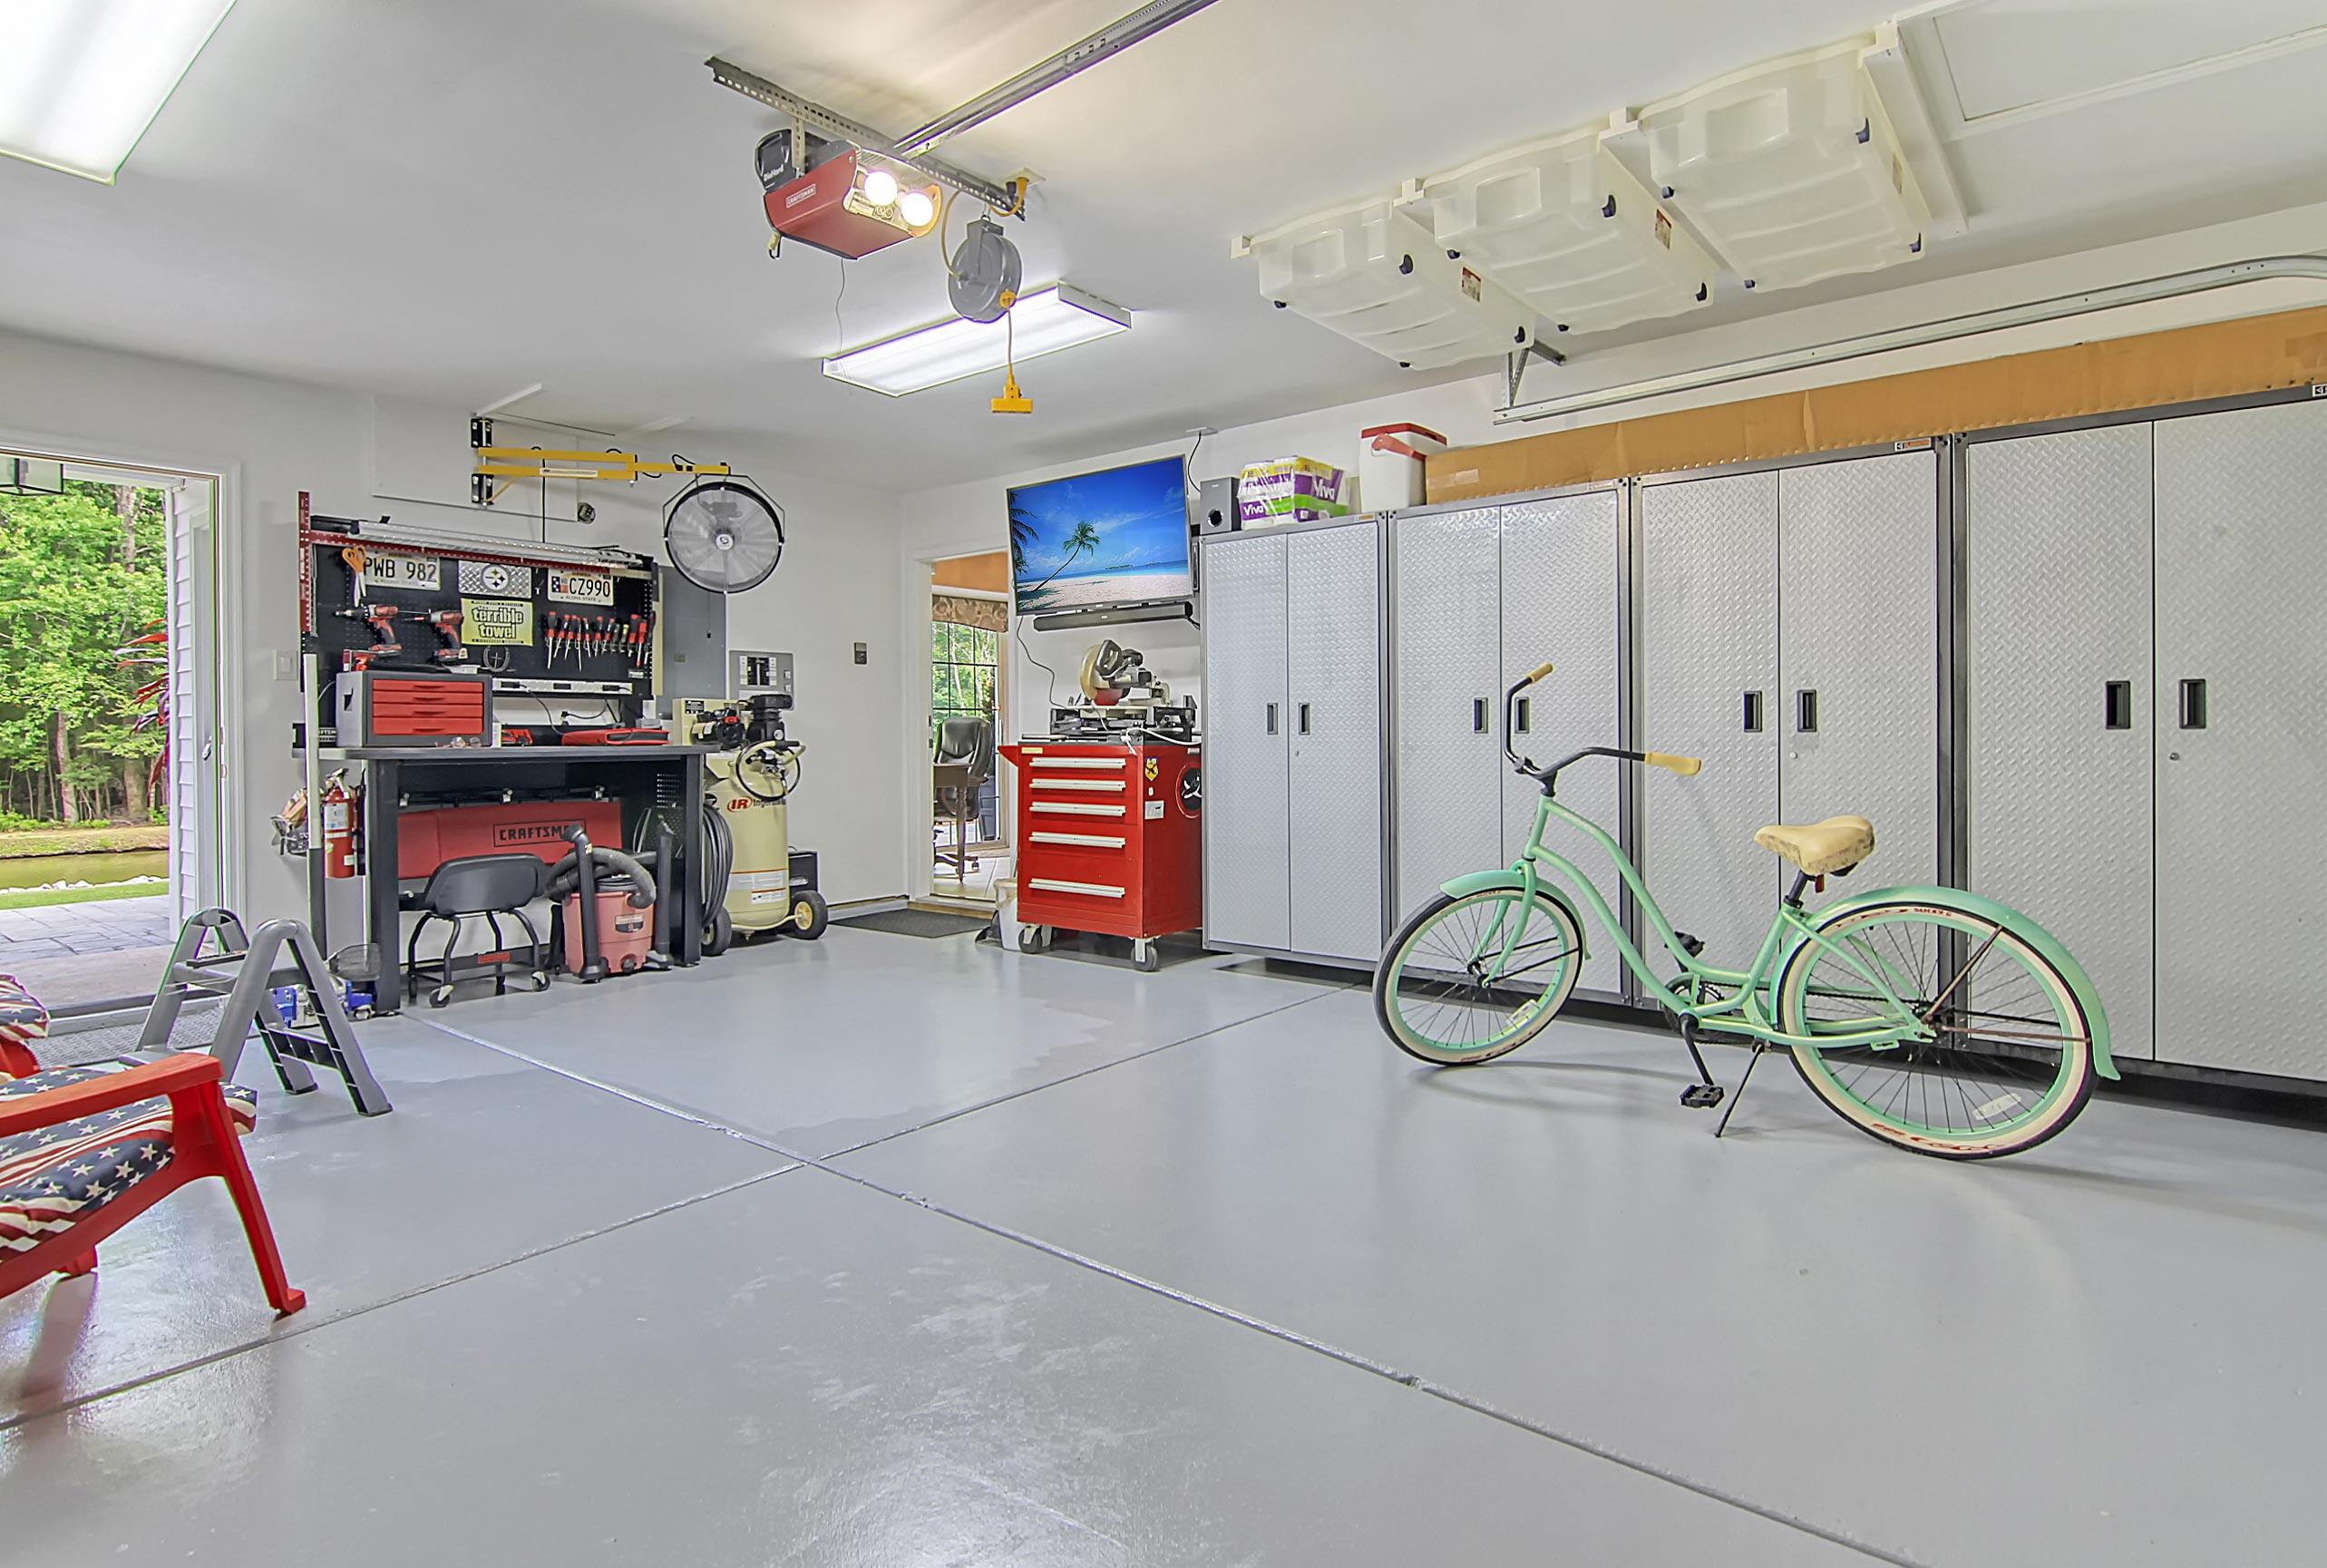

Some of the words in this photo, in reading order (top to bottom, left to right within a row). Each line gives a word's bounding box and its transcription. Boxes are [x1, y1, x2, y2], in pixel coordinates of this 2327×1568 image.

[1313, 478, 1335, 500] Viva
[1243, 504, 1263, 516] Viva
[363, 557, 395, 578] PWB
[406, 561, 437, 583] 982
[569, 577, 611, 598] CZ990
[472, 607, 524, 624] terrible
[478, 623, 517, 639] towel
[731, 799, 749, 809] IR
[499, 824, 570, 841] CRAFTSM
